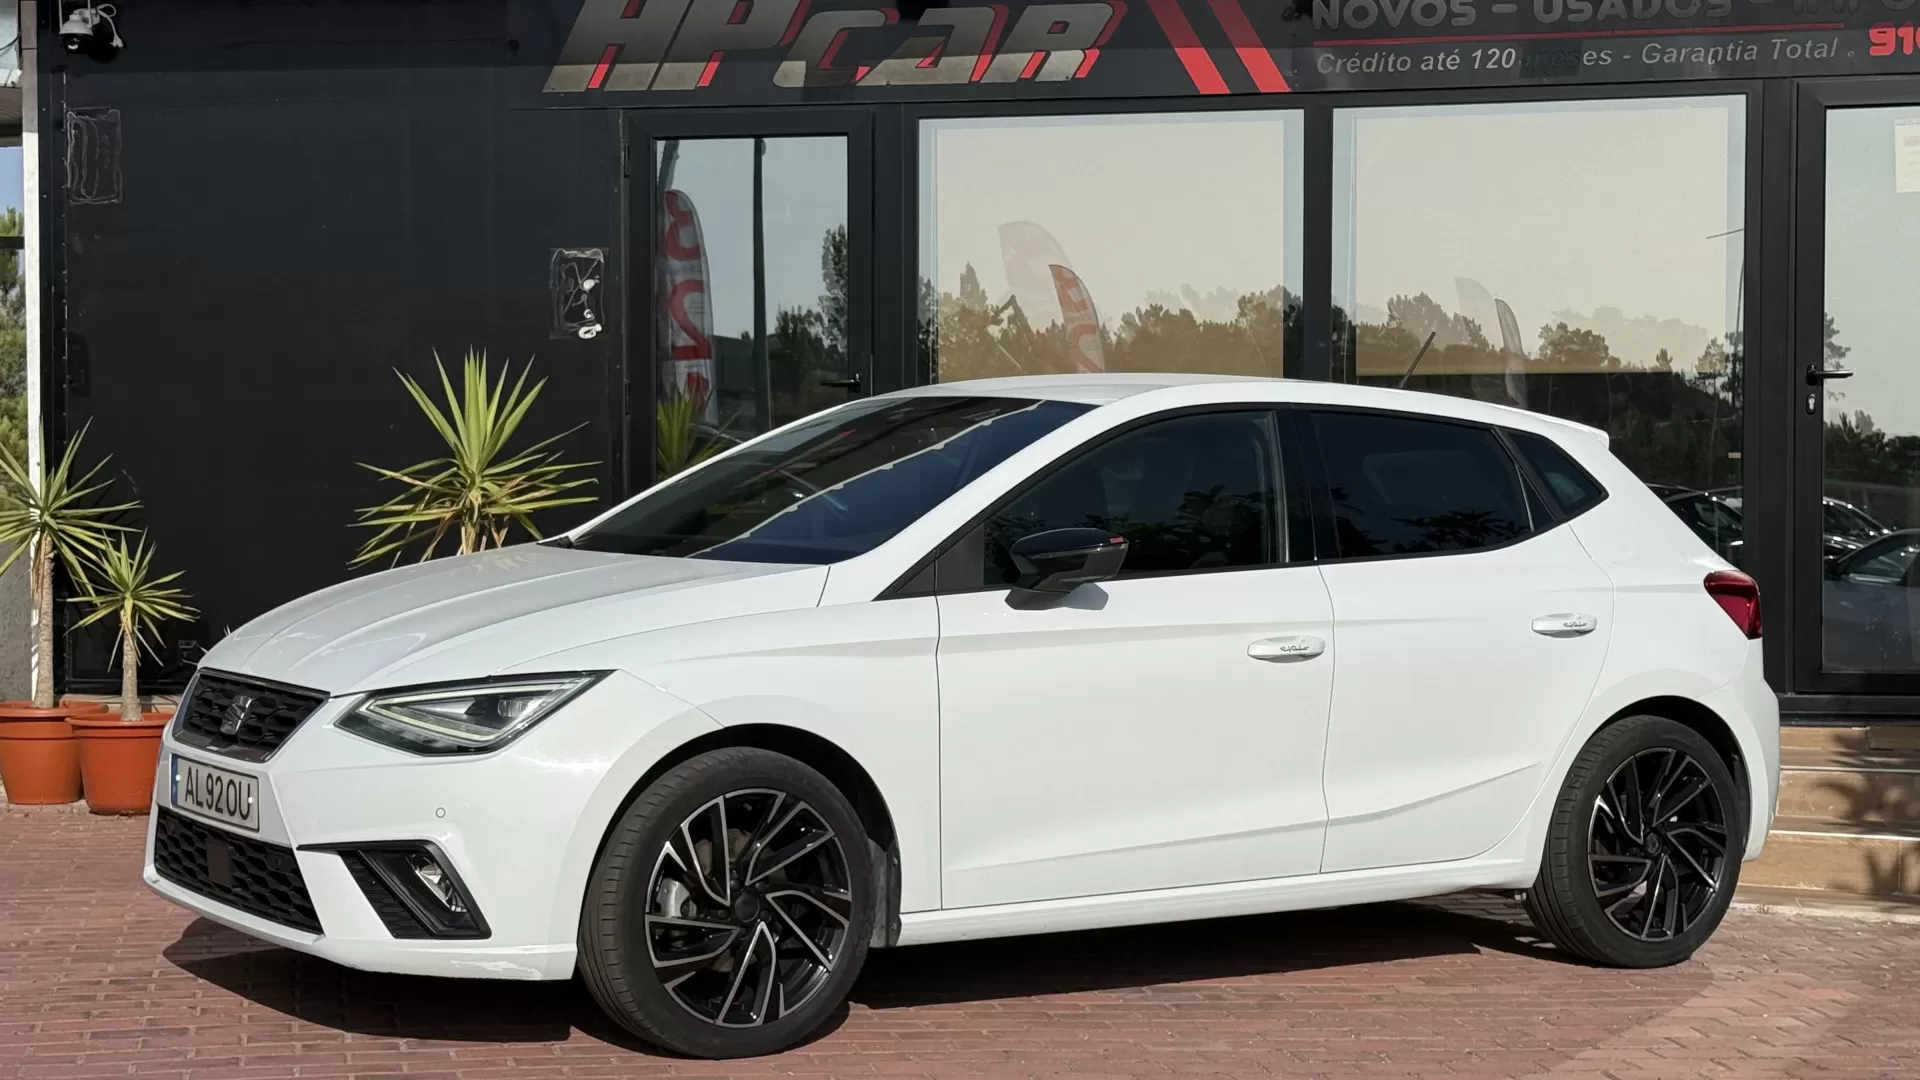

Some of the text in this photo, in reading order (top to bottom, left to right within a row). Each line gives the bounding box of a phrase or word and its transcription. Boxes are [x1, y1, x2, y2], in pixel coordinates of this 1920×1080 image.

[1312, 0, 1476, 30] NOVOS
[1533, 0, 1732, 24] USADOS
[1316, 52, 1411, 74] Crédito
[1420, 49, 1460, 71] até
[1472, 48, 1516, 69] 120
[1641, 41, 1758, 64] Garantia
[1771, 37, 1838, 60] Total
[1868, 20, 1920, 56] 91
